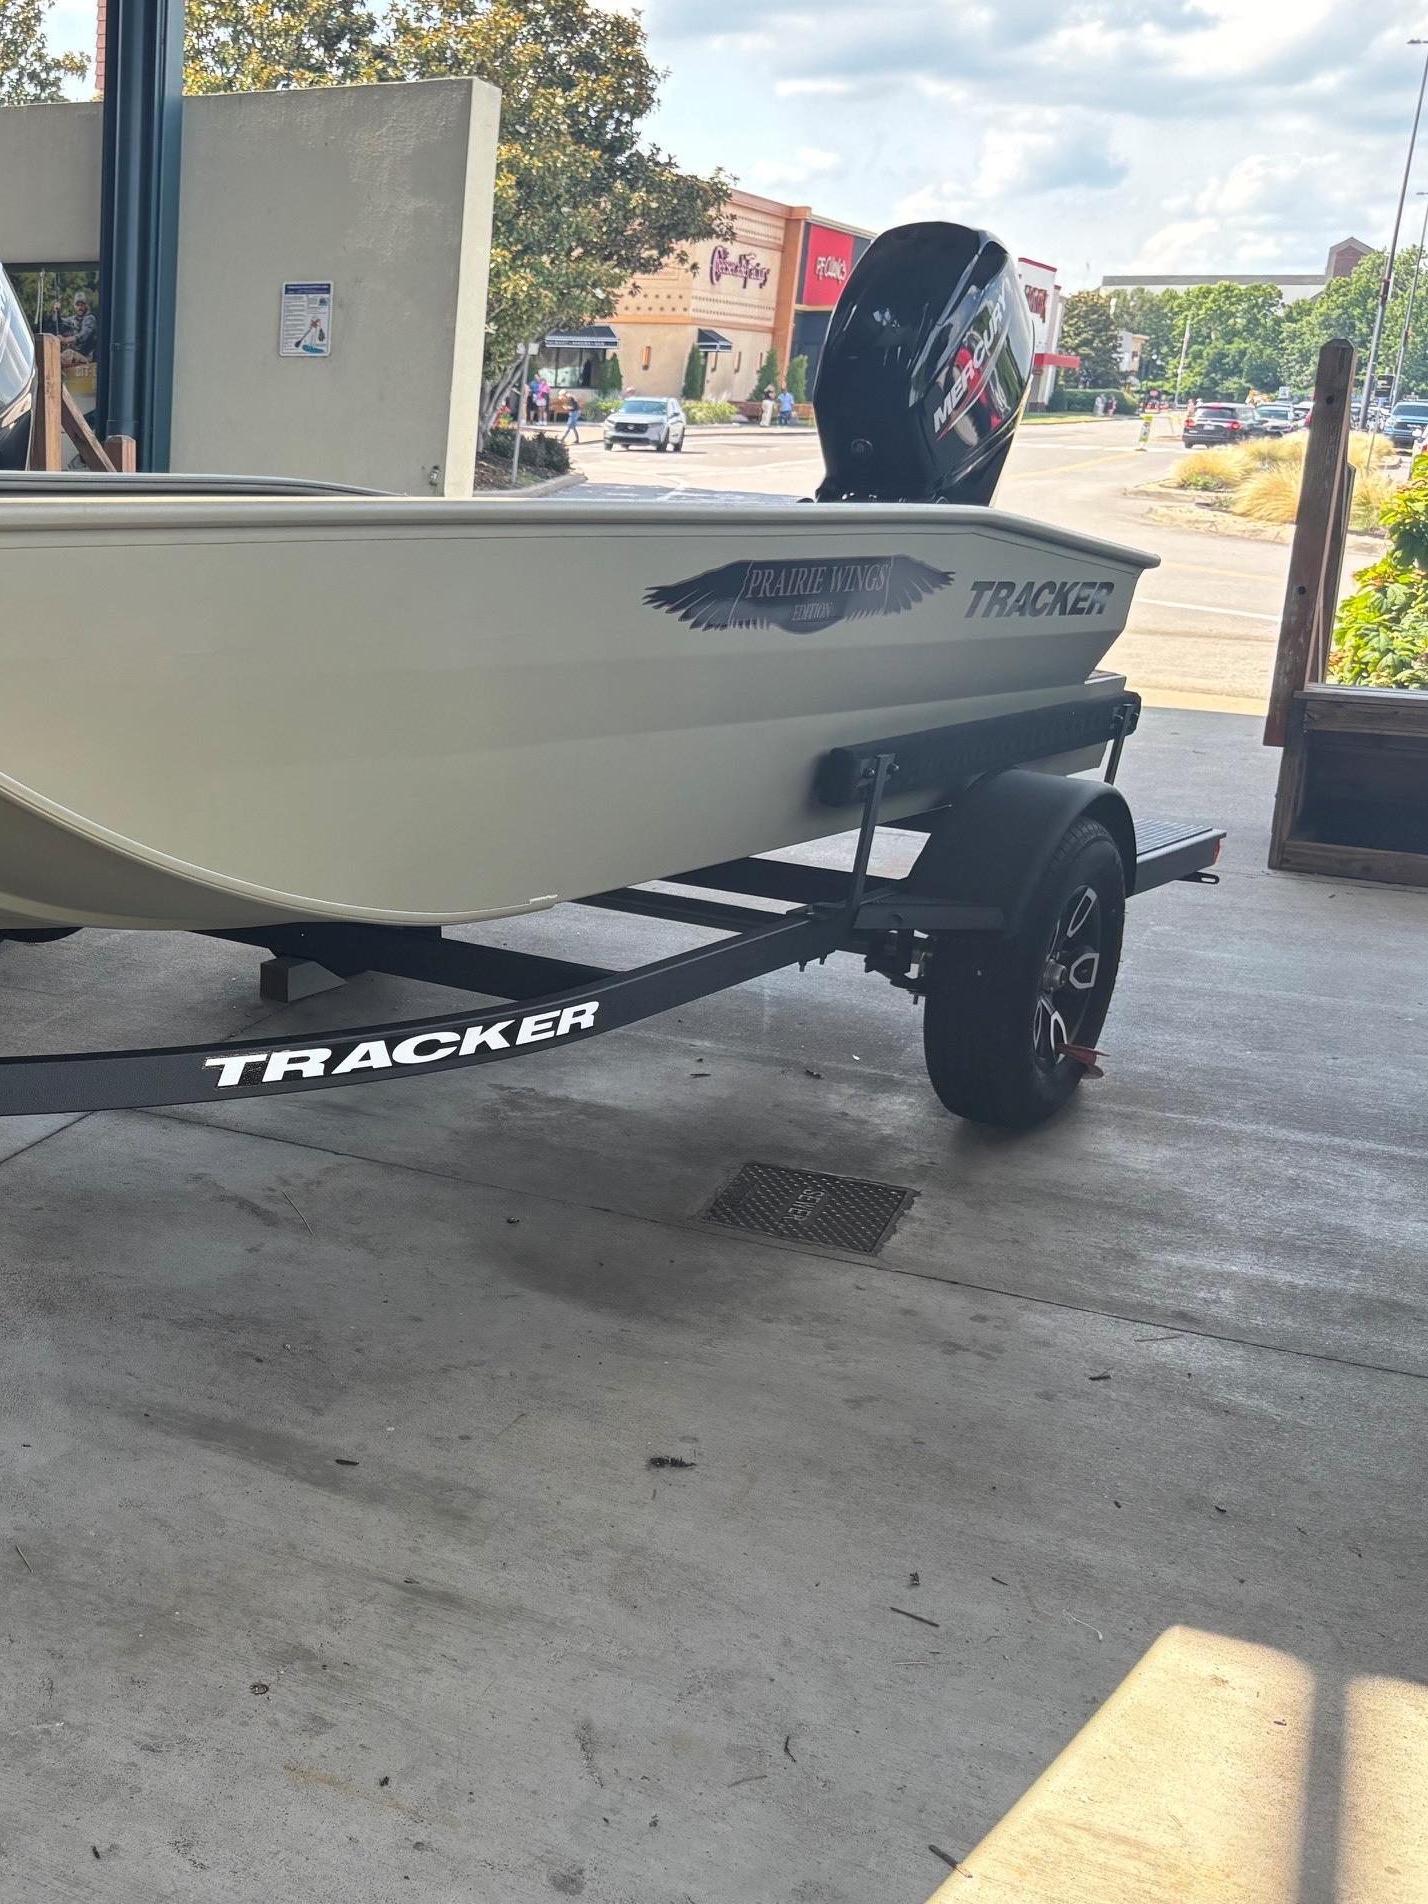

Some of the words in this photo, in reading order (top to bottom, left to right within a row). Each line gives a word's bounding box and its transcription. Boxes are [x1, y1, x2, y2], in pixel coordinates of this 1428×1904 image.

[933, 281, 1006, 433] MERCURY
[745, 565, 824, 599] PRAIRIE
[828, 562, 891, 595] WINGS
[964, 580, 1115, 619] TRACKER
[790, 601, 833, 621] EDITION
[204, 1000, 600, 1088] TRACKER
